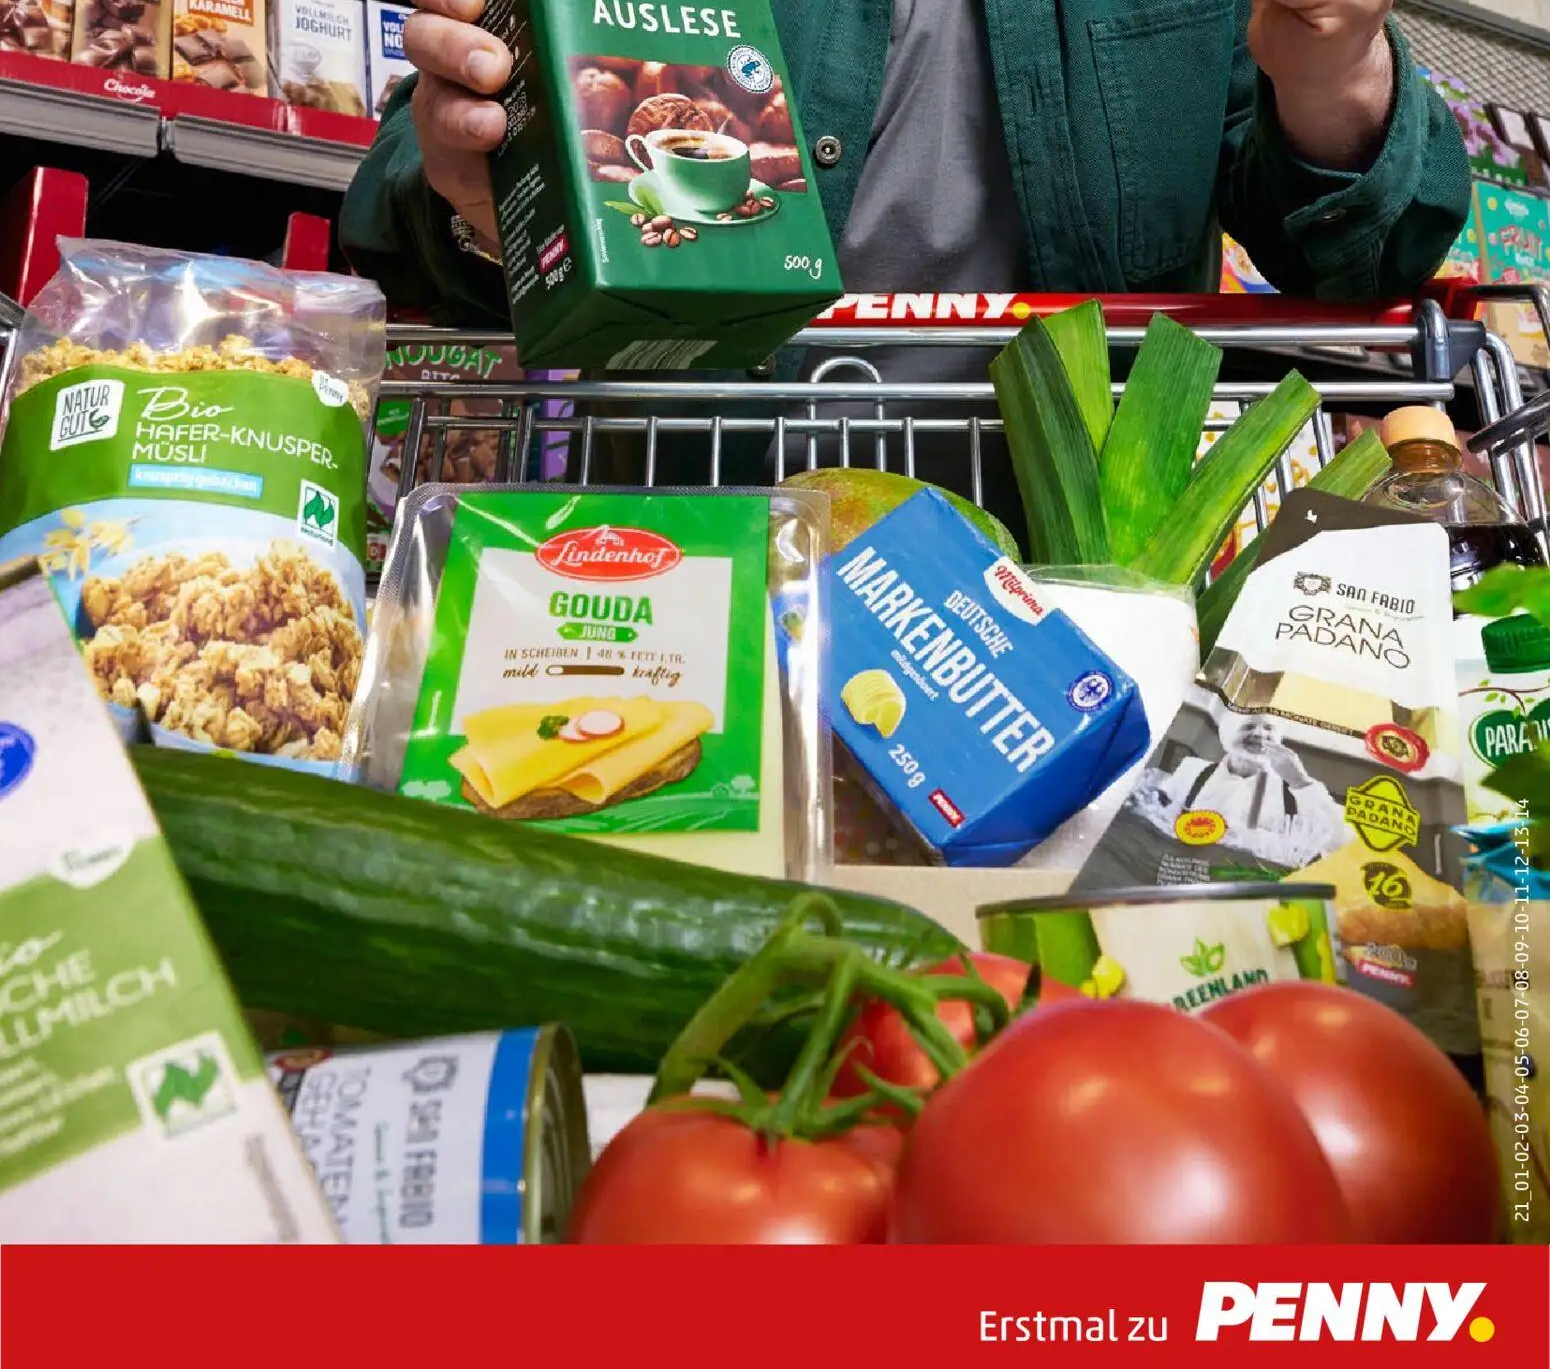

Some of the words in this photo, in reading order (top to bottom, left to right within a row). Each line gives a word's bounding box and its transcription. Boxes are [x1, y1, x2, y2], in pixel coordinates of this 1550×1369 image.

[294, 3, 350, 26] VOLLMILCH
[294, 16, 354, 43] JOGHURT
[783, 255, 810, 270] 500
[385, 344, 503, 379] NOUGAT
[63, 383, 110, 410] NATUR
[136, 386, 235, 422] Bio
[59, 409, 90, 439] GUT
[131, 440, 208, 464] MÜSLI
[135, 421, 340, 471] HAFER-KNUSPER-
[550, 539, 669, 569] Lindenhof
[993, 564, 1045, 617] Milprima
[1336, 582, 1366, 603] SAN
[1370, 590, 1416, 615] FABIO
[547, 590, 654, 625] GOUDA
[580, 624, 617, 641] JUNG
[942, 589, 1015, 660] DEUTSCHE
[1288, 604, 1405, 650] GRANA
[503, 648, 517, 660] IN
[520, 647, 579, 659] SCHEIBEN
[835, 545, 1057, 774] MARKENBUTTER
[1275, 621, 1411, 670] PADANO
[502, 663, 541, 679] mild
[631, 665, 684, 688] kräftig
[1346, 806, 1416, 836] PADANO
[1349, 794, 1418, 828] GRANA
[0, 949, 96, 1013] CHE
[1172, 967, 1269, 1012] REENLAND
[0, 956, 178, 1059] LLMILCH
